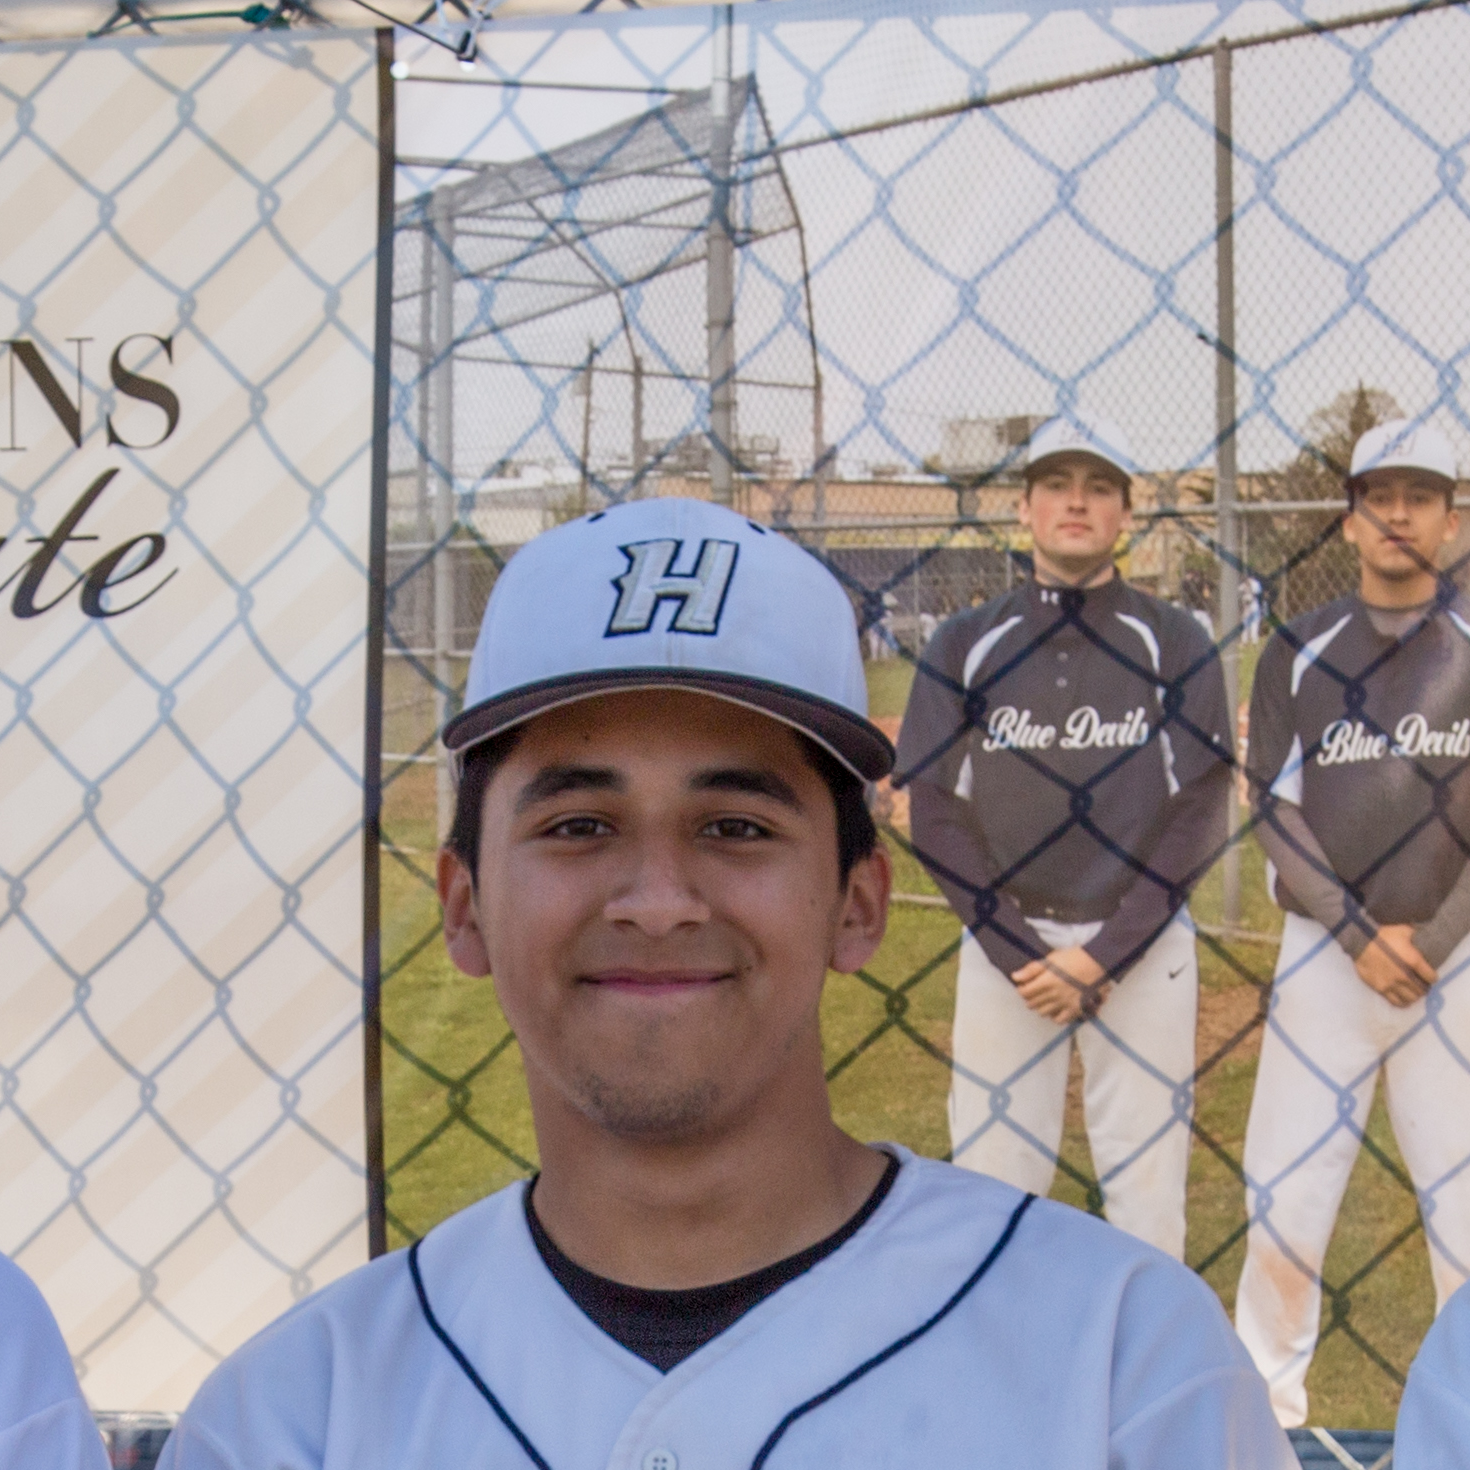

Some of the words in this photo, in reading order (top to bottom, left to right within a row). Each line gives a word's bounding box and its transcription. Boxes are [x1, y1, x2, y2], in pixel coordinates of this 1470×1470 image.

[603, 537, 740, 638] H
[981, 704, 1055, 751] Blue
[1059, 706, 1149, 751] Devils
[1316, 720, 1388, 767] Blue
